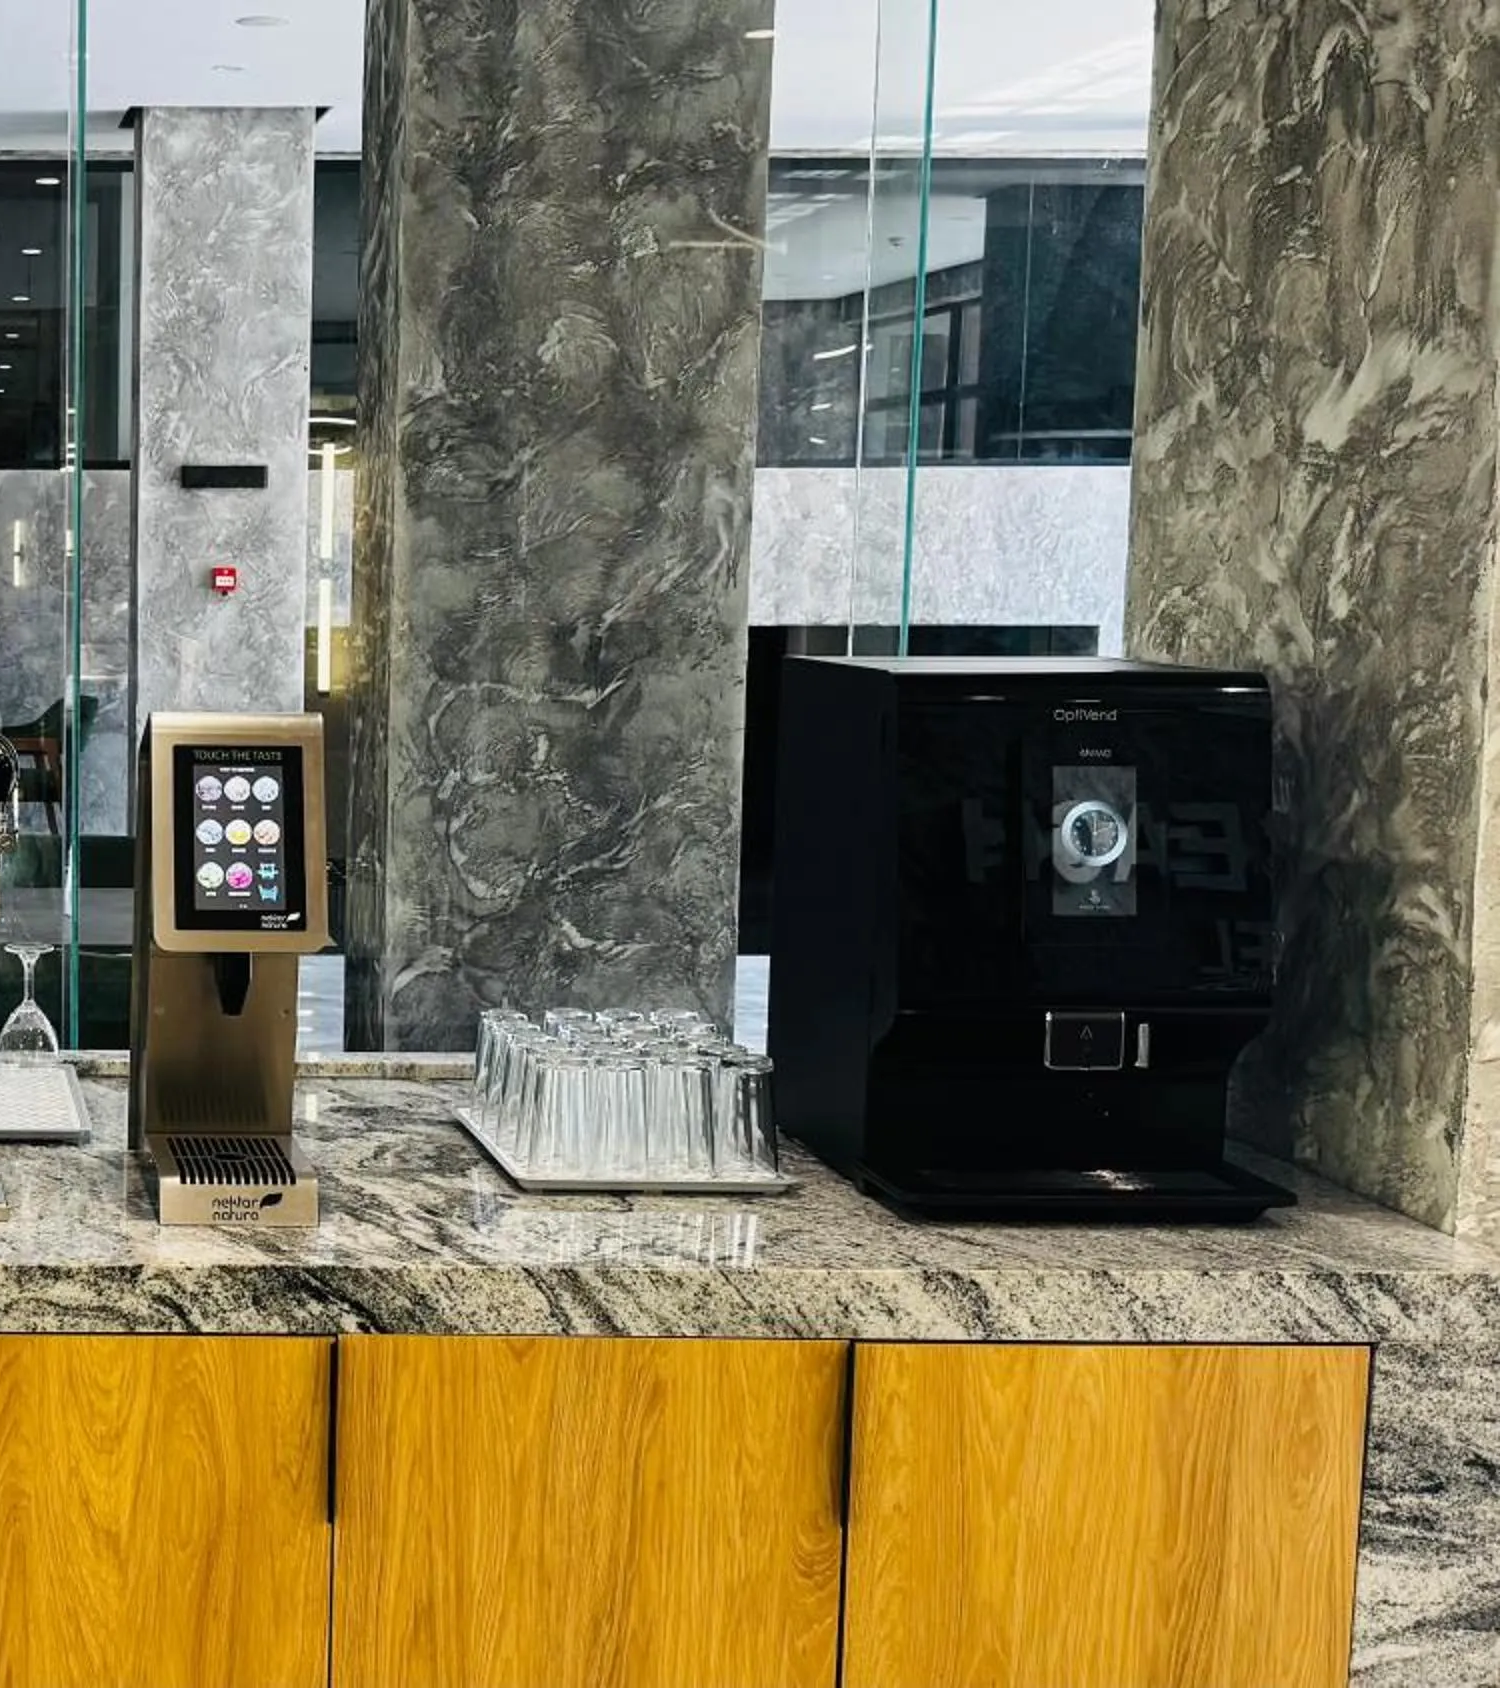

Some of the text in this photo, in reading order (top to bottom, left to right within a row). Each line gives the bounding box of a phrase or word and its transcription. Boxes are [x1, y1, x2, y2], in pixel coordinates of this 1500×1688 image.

[1053, 708, 1117, 724] OptiVend
[194, 750, 282, 761] TOUCH THE TASTE
[212, 1195, 260, 1209] nektar
[212, 1209, 260, 1221] natura
